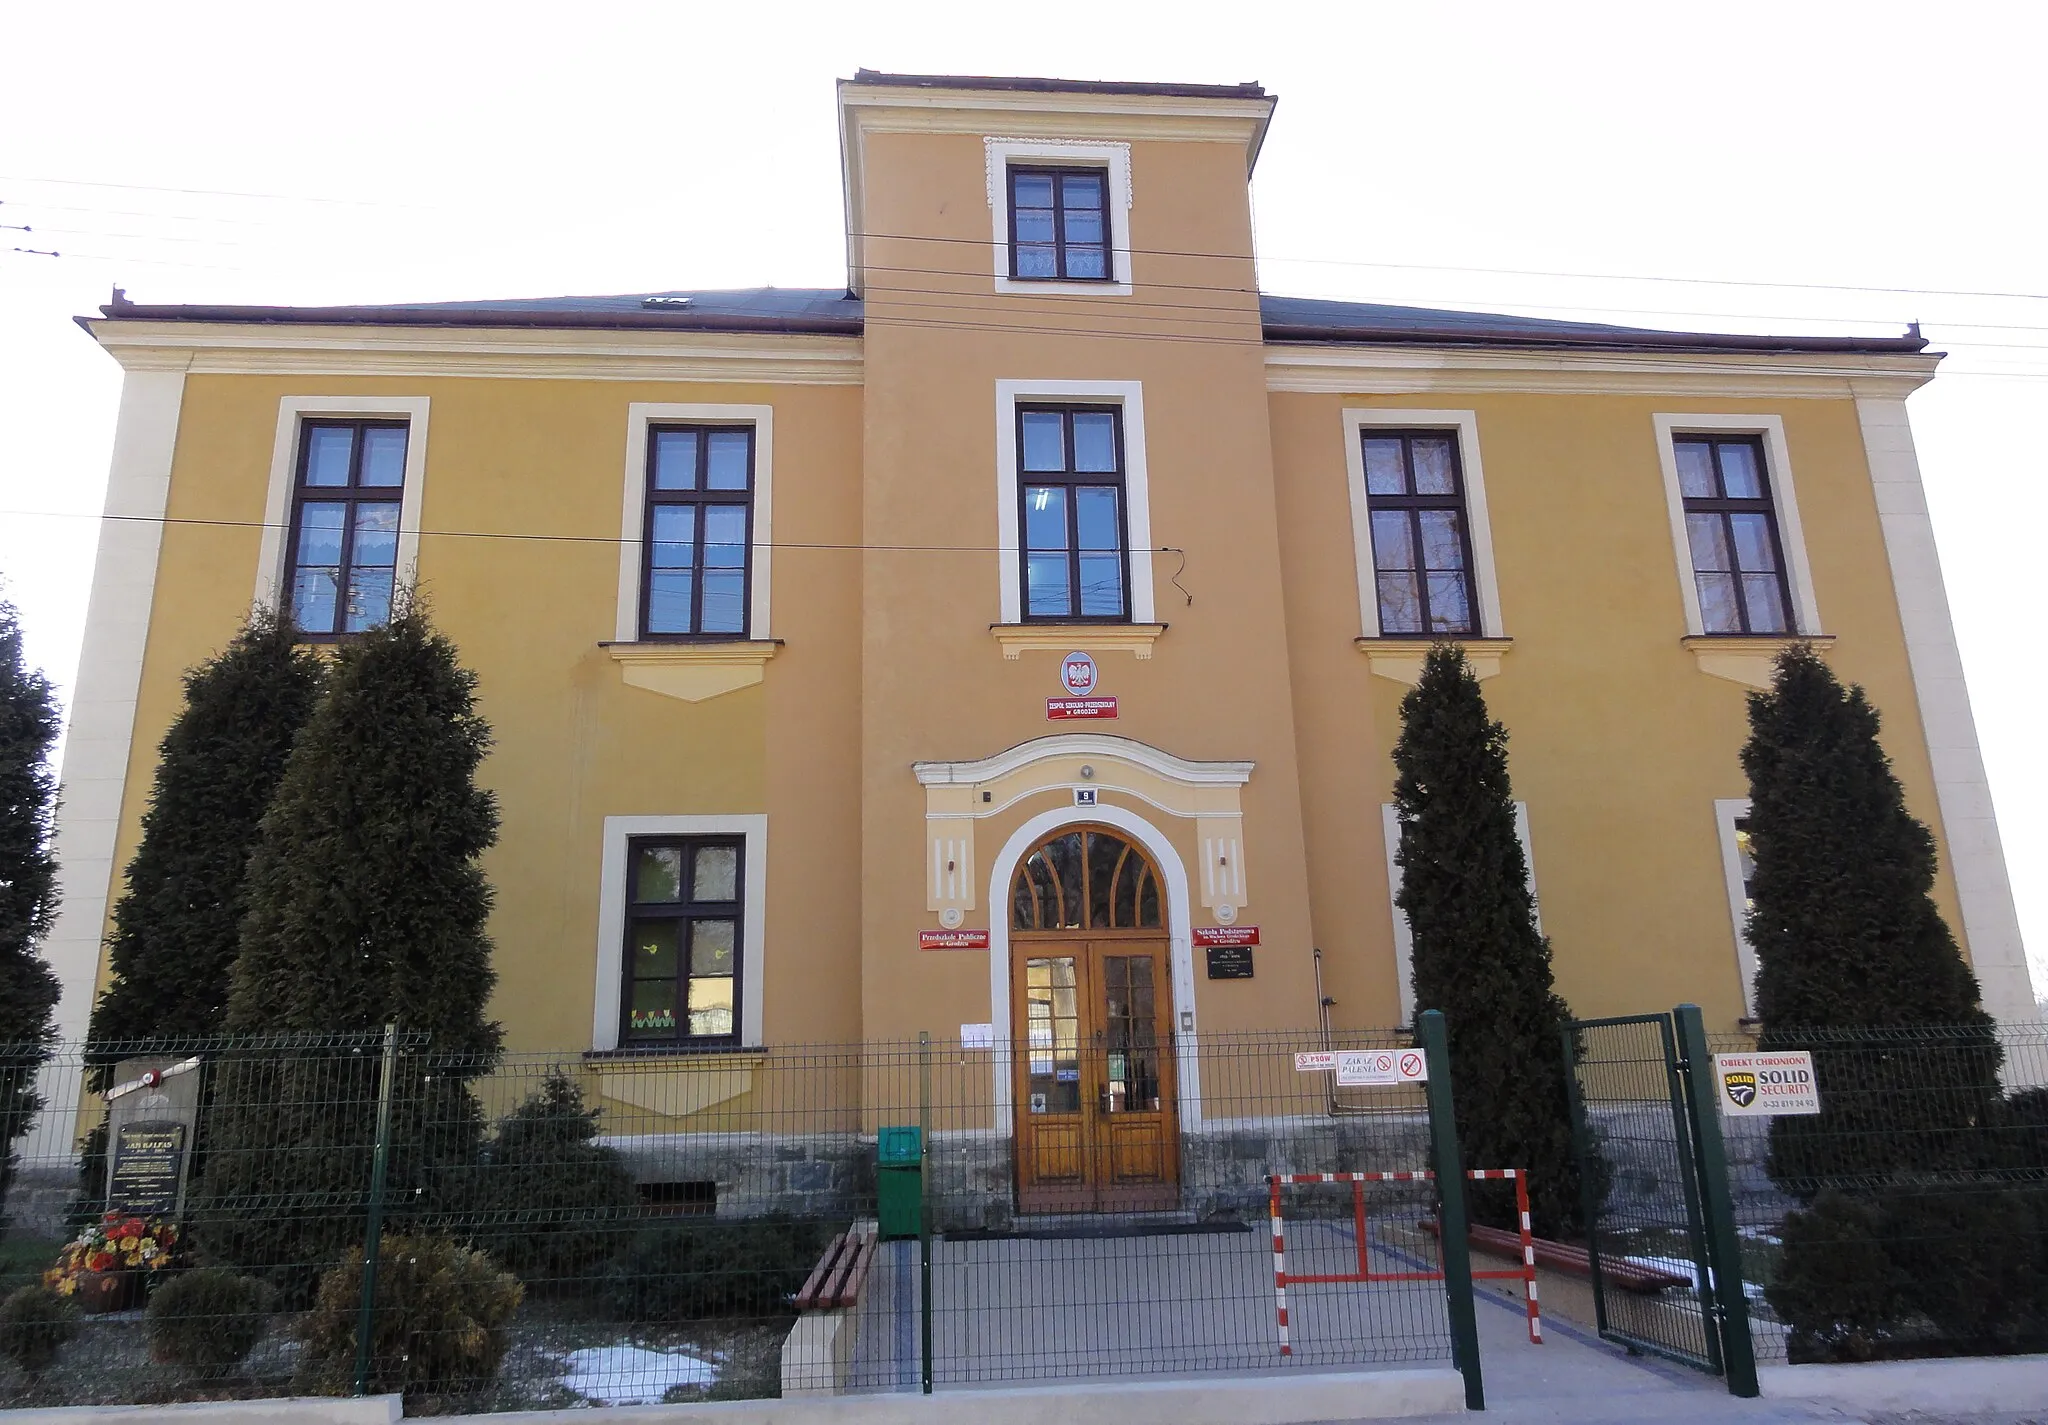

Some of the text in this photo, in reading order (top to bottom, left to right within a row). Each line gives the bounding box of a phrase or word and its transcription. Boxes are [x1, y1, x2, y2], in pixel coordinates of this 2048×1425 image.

[1083, 791, 1089, 800] 9
[1345, 1057, 1373, 1065] ZAKAZ
[1720, 1057, 1807, 1067] OBIEKT CHRONIONY
[1342, 1065, 1377, 1073] PALENIA
[1726, 1075, 1754, 1085] SOLID
[1759, 1069, 1809, 1085] SOLID
[1760, 1084, 1811, 1095] SECURITY
